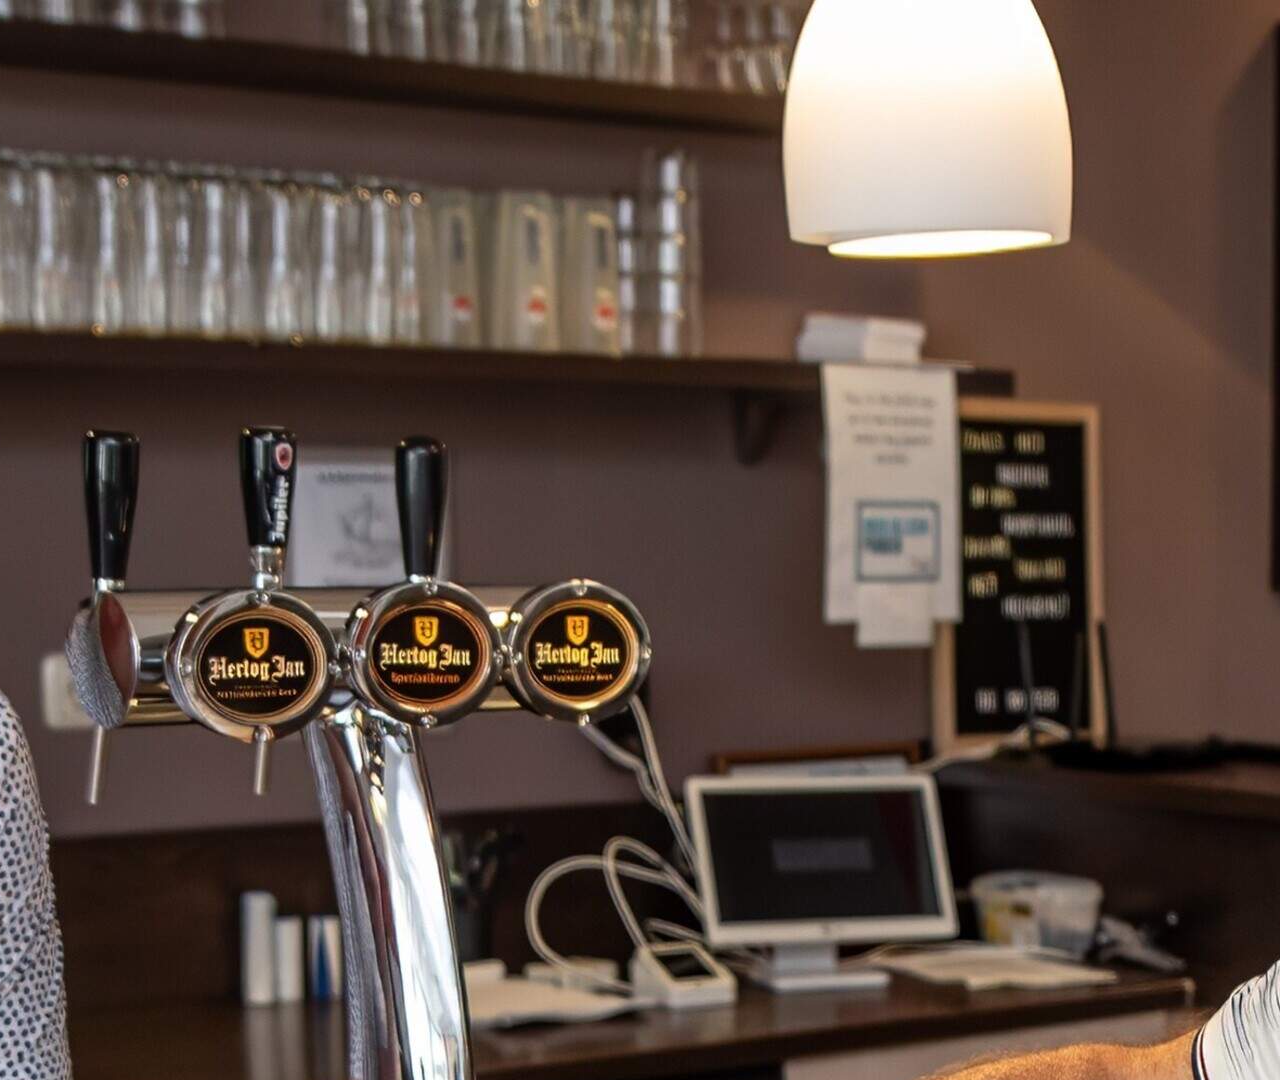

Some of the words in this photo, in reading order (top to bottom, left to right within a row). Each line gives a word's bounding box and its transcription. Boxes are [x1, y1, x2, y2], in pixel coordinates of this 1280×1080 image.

[271, 475, 289, 542] Jupiler
[380, 642, 438, 670] Hertog
[439, 643, 471, 670] Jan
[535, 641, 589, 669] Hertog
[590, 641, 620, 668] Jan
[208, 655, 271, 686] Hertog
[271, 655, 305, 683] Jan
